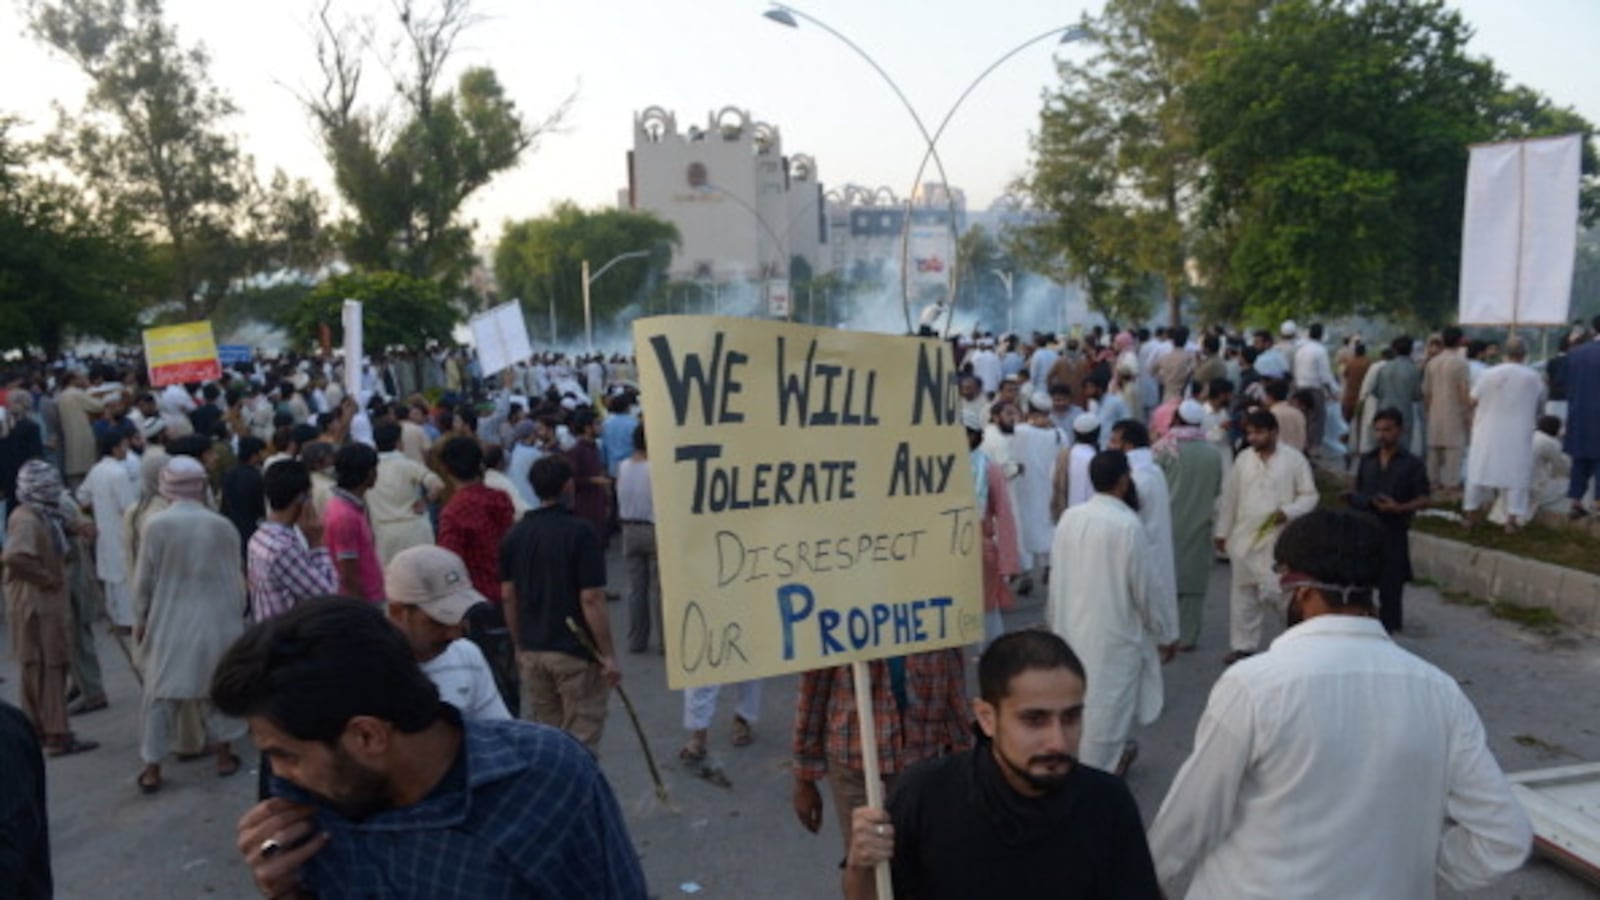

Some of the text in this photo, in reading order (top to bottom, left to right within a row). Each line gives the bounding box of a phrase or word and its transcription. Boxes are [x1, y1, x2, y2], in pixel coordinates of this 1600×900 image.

[650, 332, 956, 427] WE WILL NO
[675, 441, 956, 514] TOLERATE ANY
[715, 506, 974, 587] DISRESPECT TO
[681, 601, 748, 673] OUR
[776, 583, 954, 661] PROPHET
